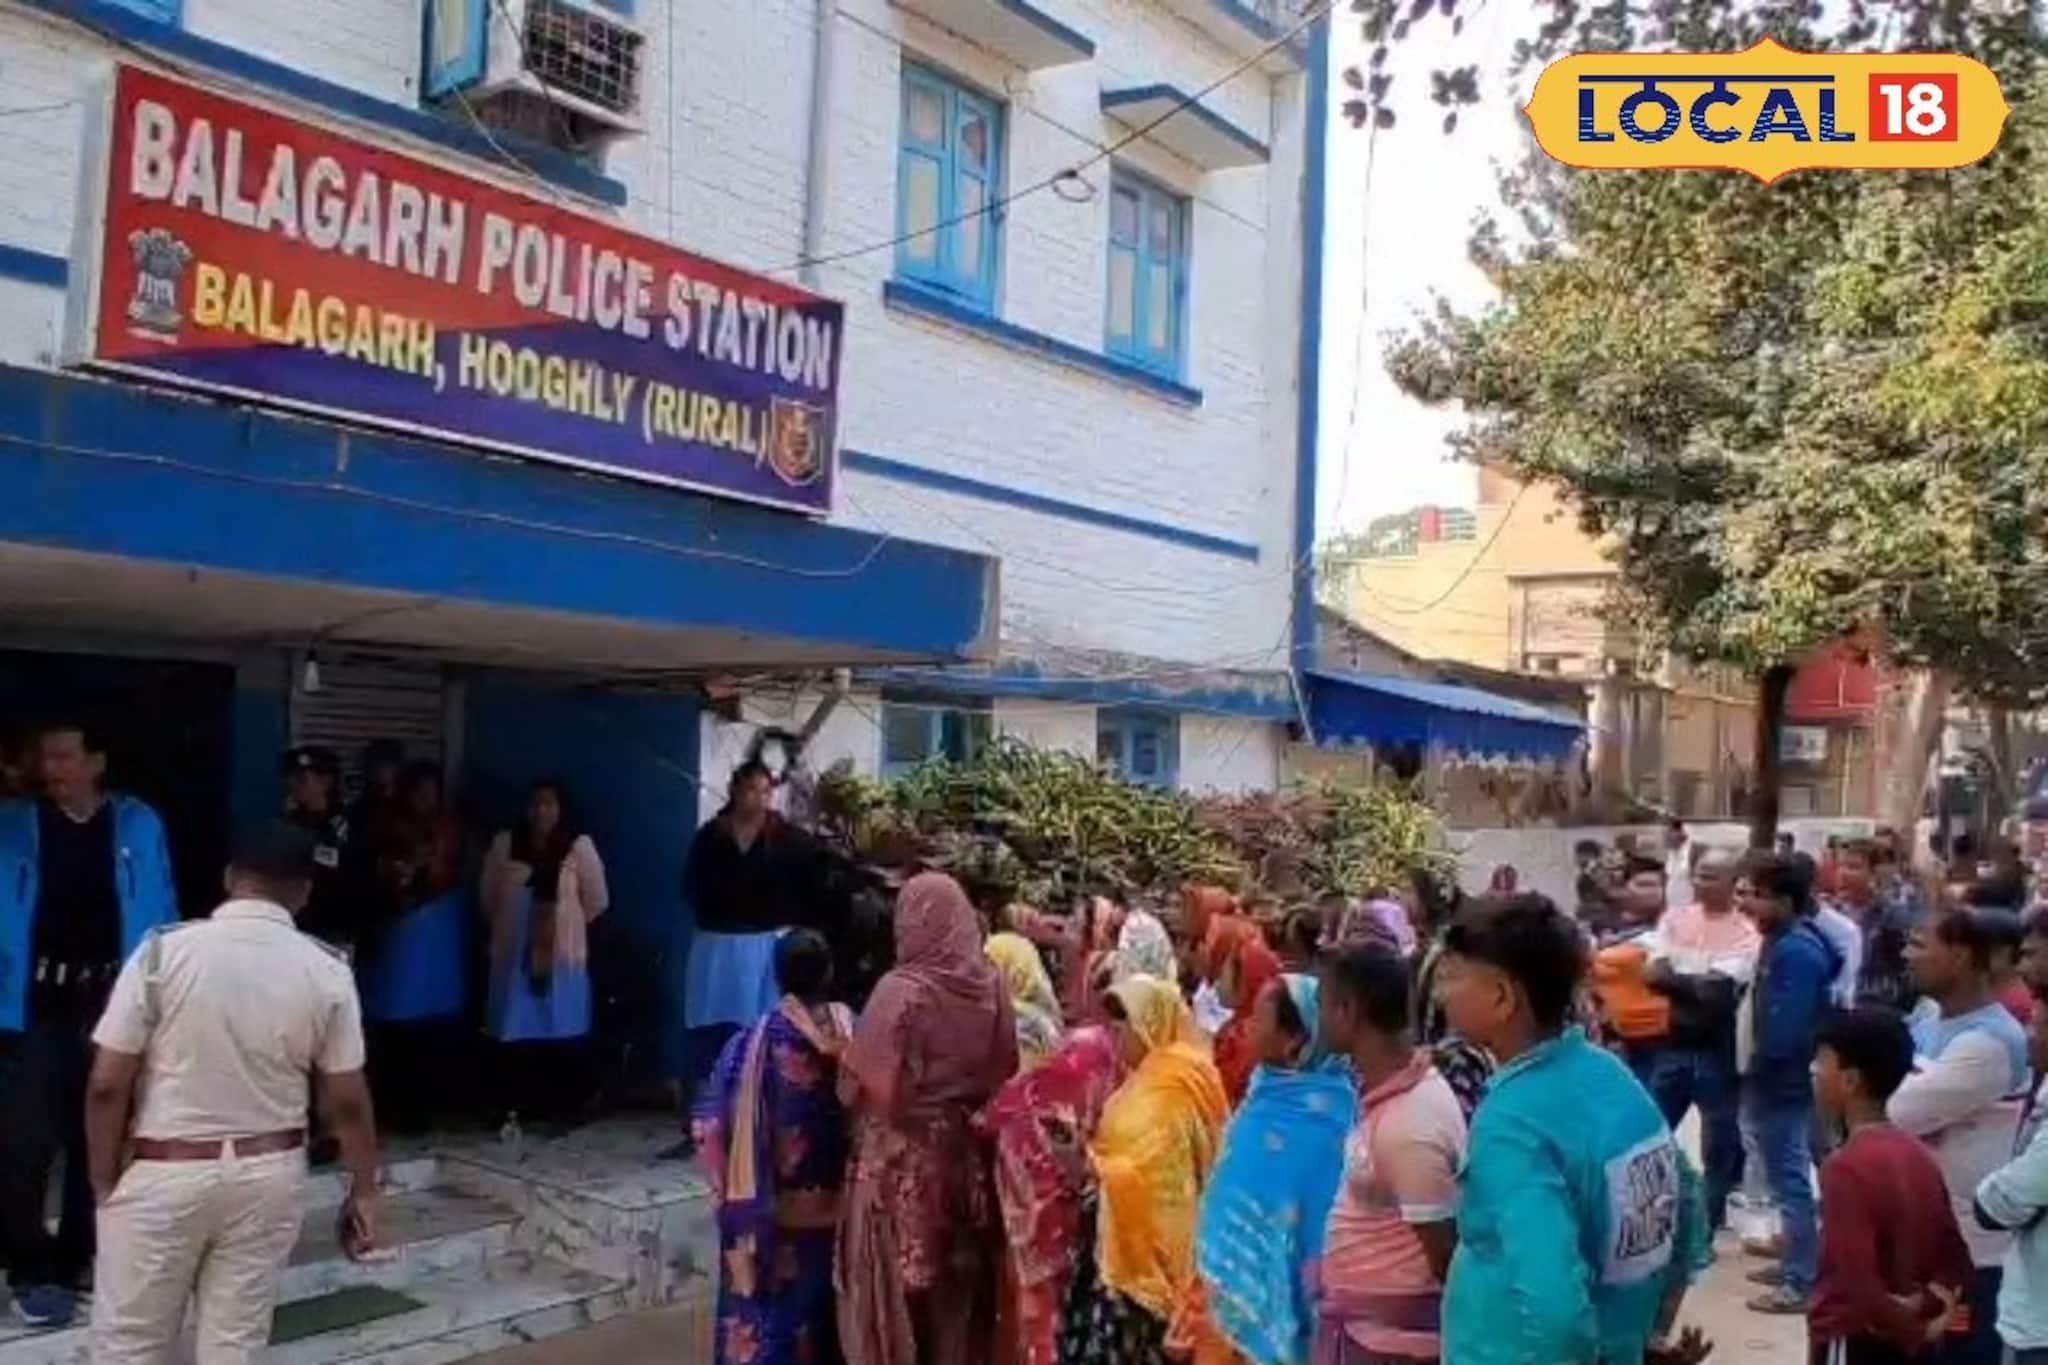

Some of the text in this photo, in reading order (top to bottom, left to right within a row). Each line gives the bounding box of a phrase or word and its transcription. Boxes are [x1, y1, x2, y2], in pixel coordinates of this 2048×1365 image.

[130, 98, 833, 391] BALAGARH POLICE STATION
[193, 261, 768, 469] BALAGARH, HOOGHLY (RURAL)
